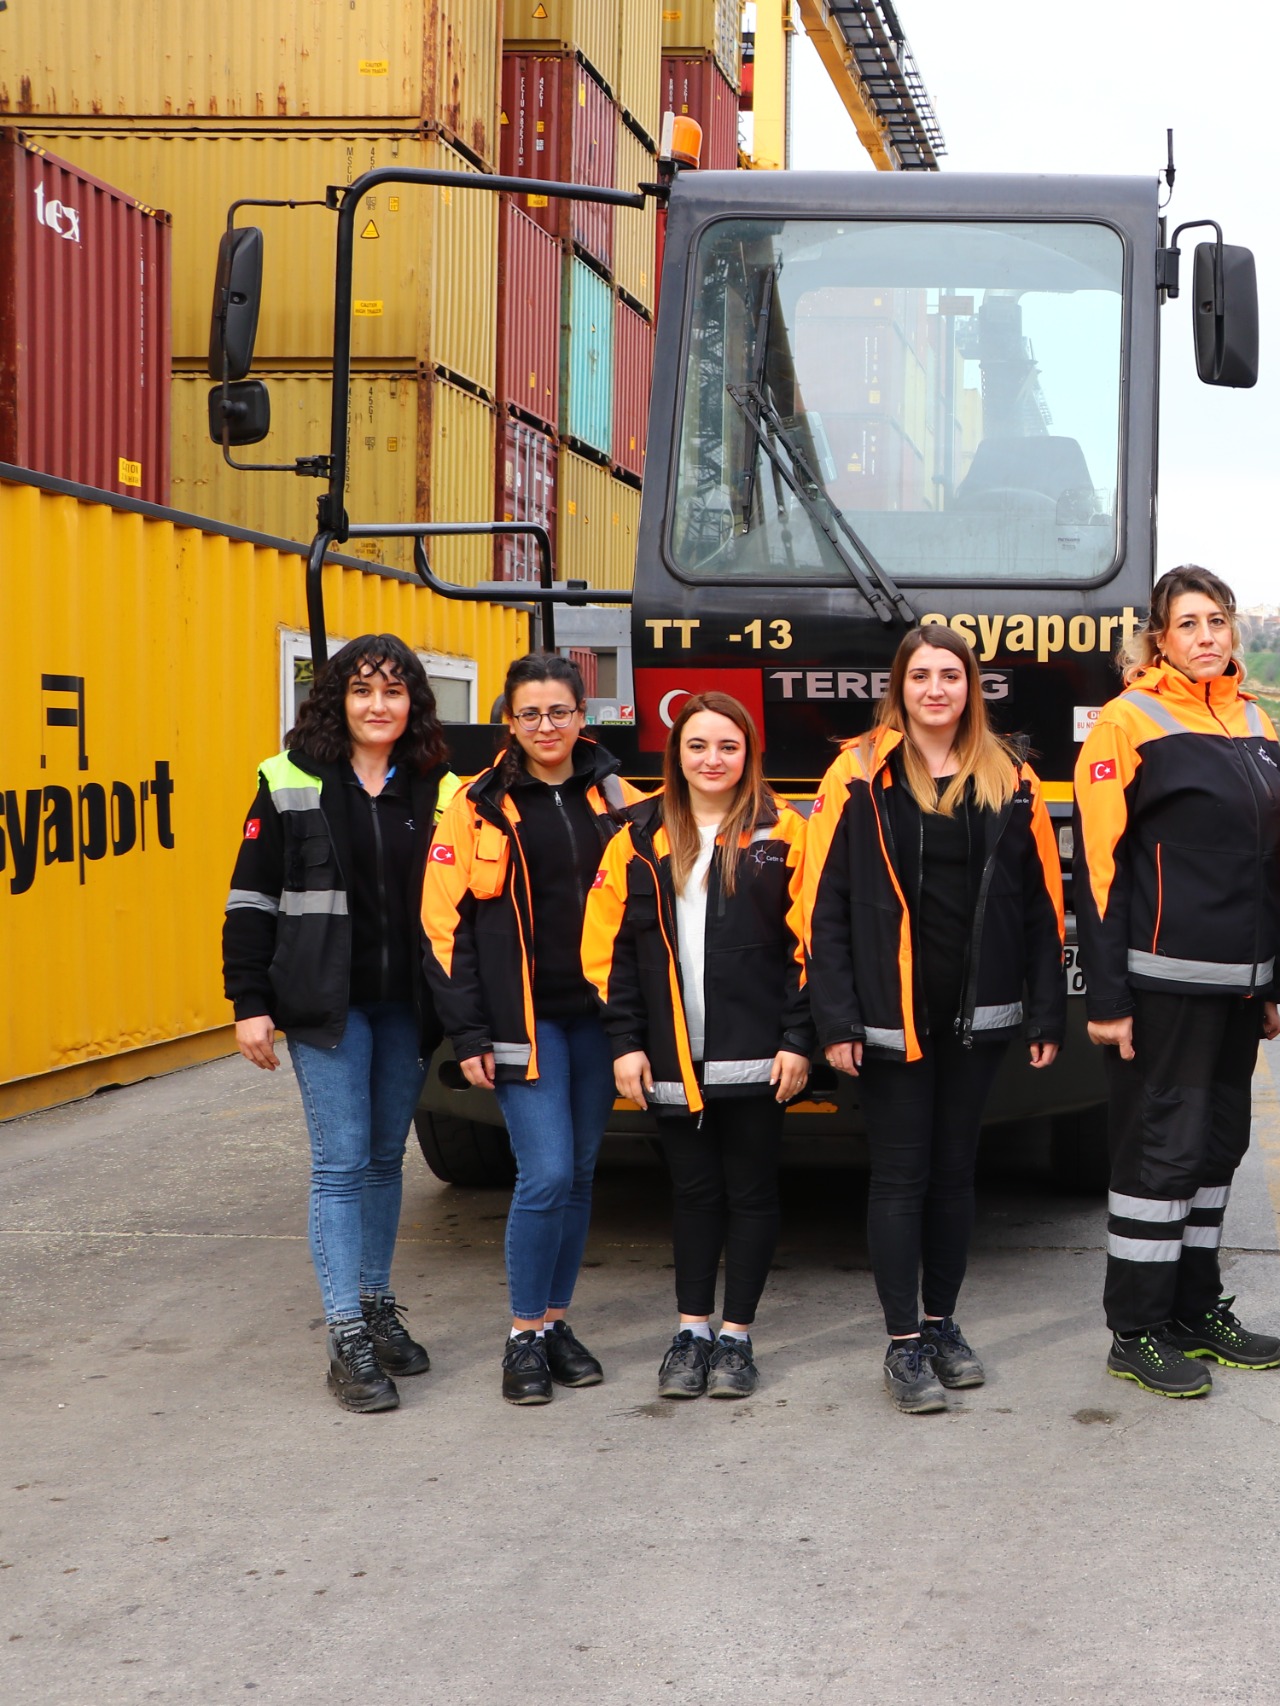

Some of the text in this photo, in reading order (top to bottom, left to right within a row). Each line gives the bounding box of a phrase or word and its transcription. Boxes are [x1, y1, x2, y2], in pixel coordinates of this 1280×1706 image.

[33, 180, 80, 243] tex
[645, 619, 700, 649] TT
[769, 671, 1009, 700] TERG
[0, 760, 174, 895] yaport
